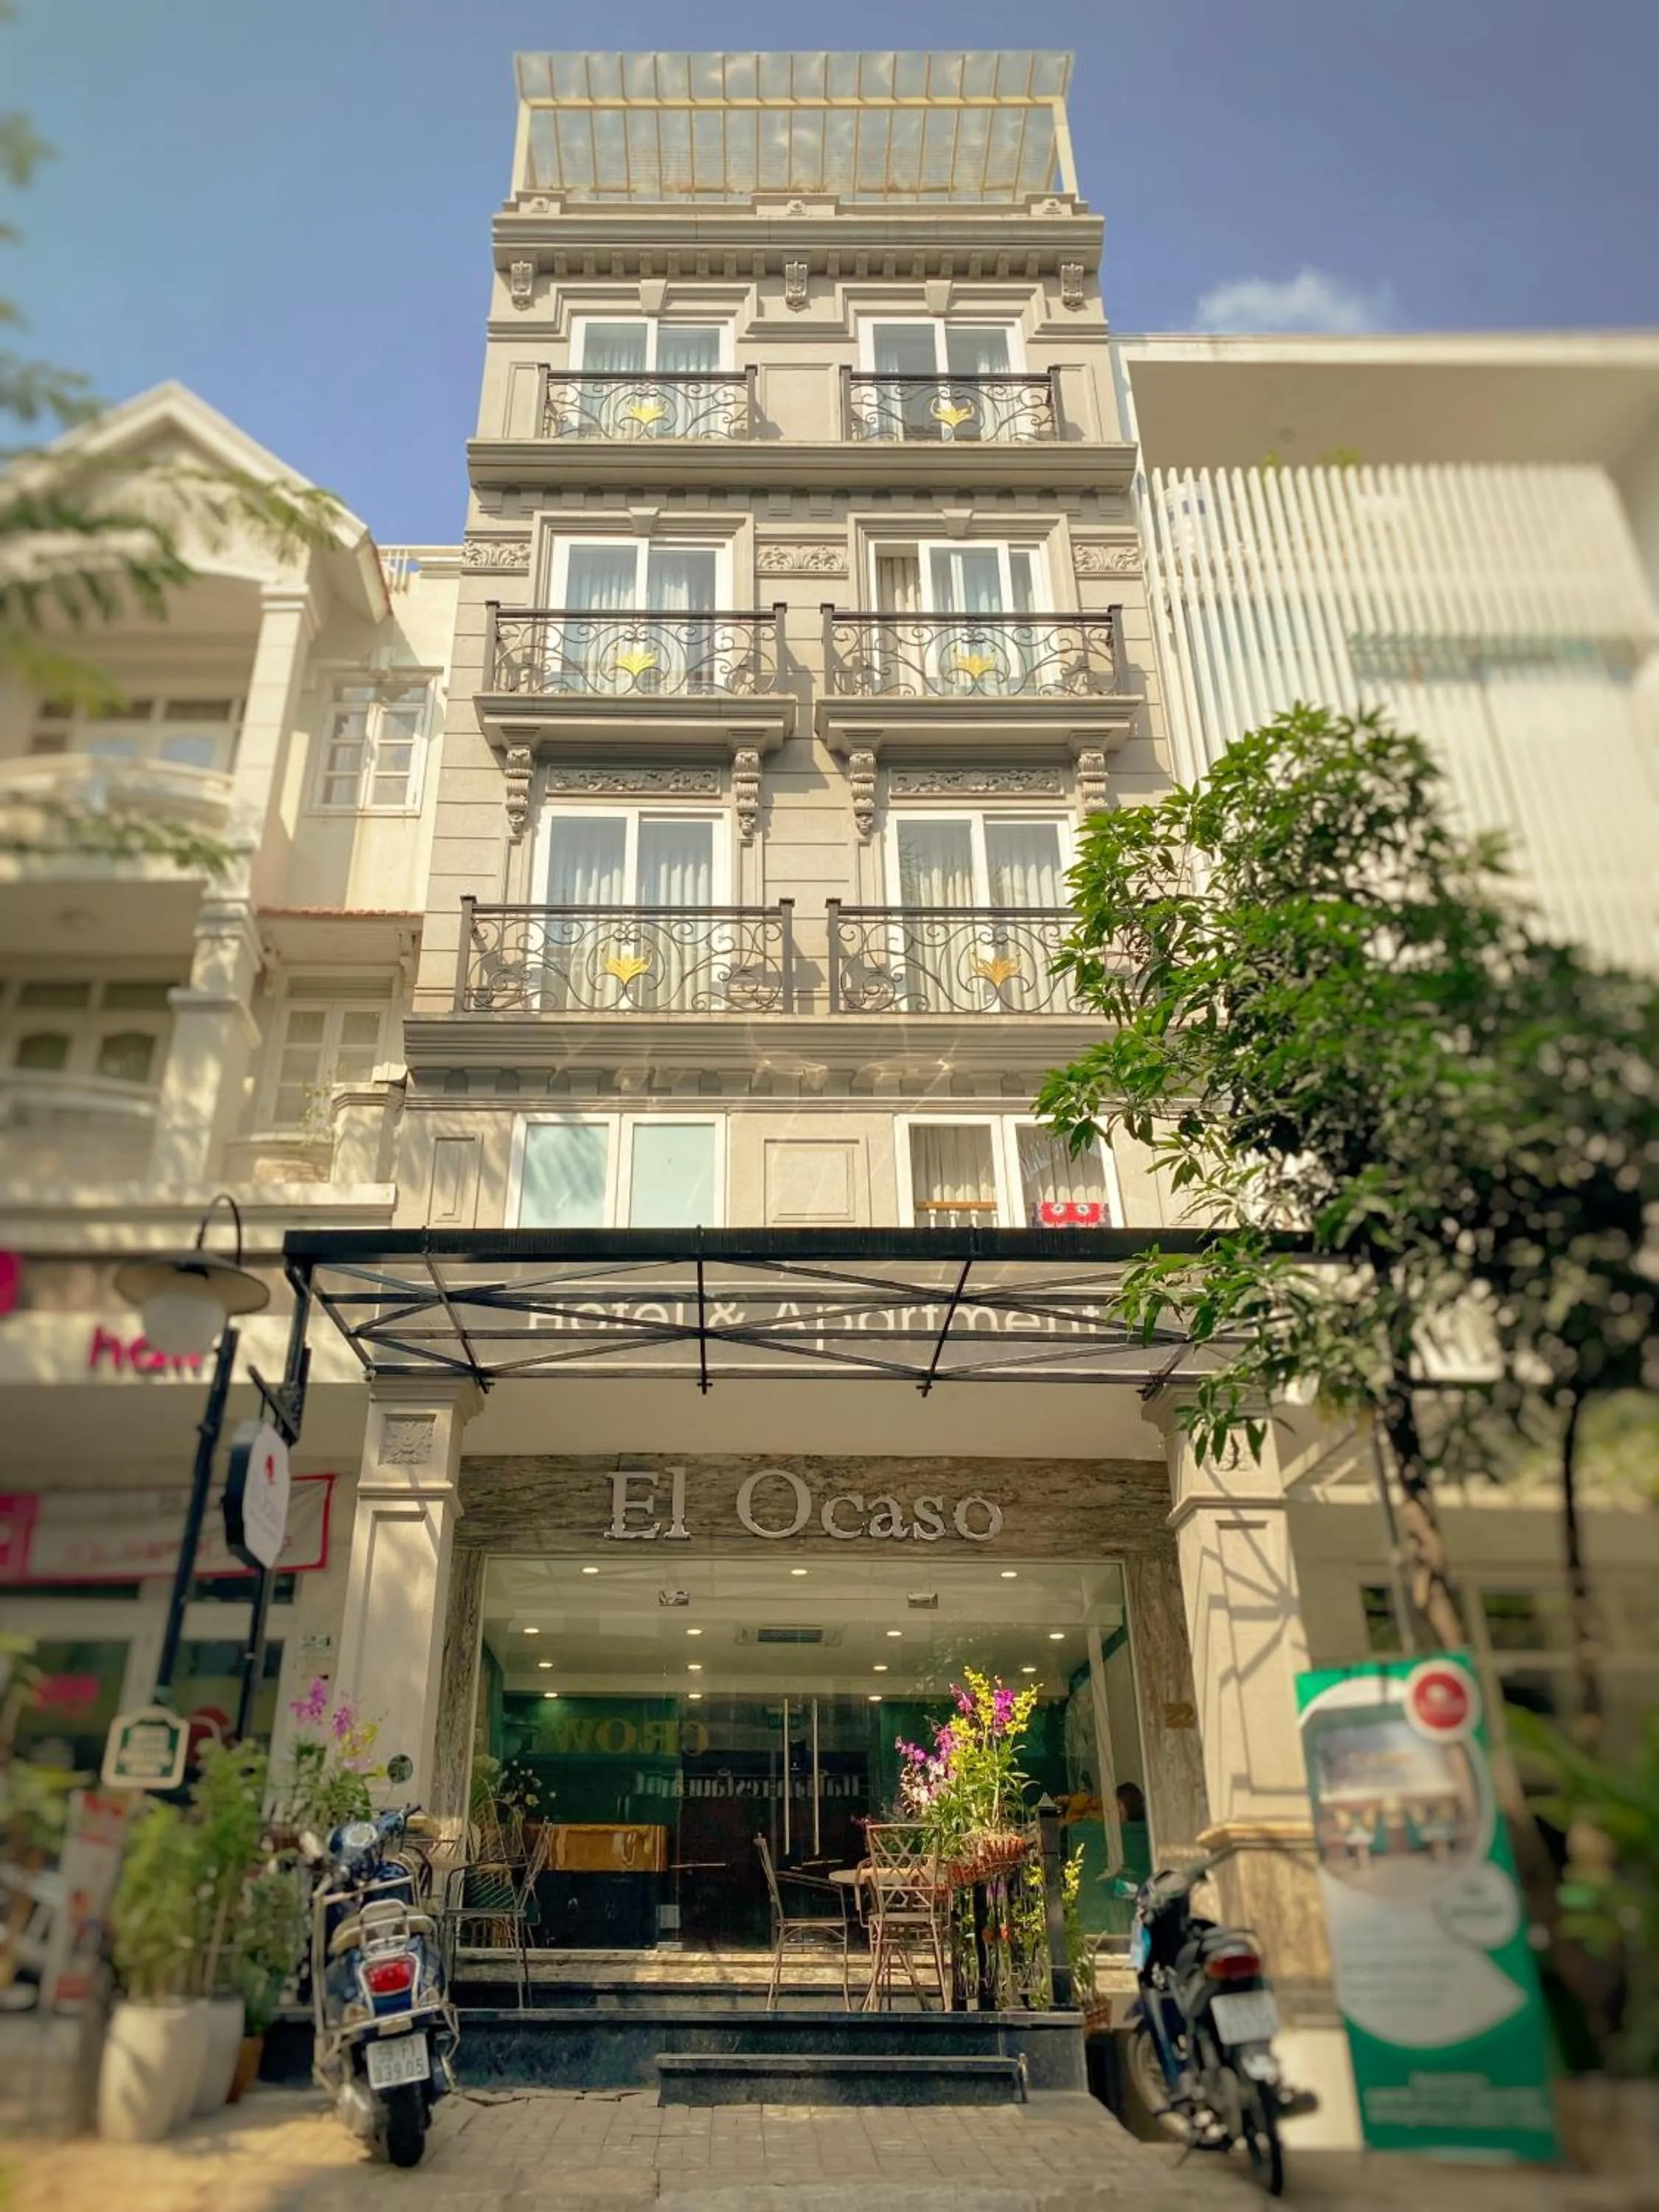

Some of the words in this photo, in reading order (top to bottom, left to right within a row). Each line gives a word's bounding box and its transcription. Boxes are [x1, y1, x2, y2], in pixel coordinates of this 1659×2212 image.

[528, 1300, 684, 1331] Hotel
[603, 1466, 691, 1540] El
[736, 1469, 1004, 1543] Ocaso
